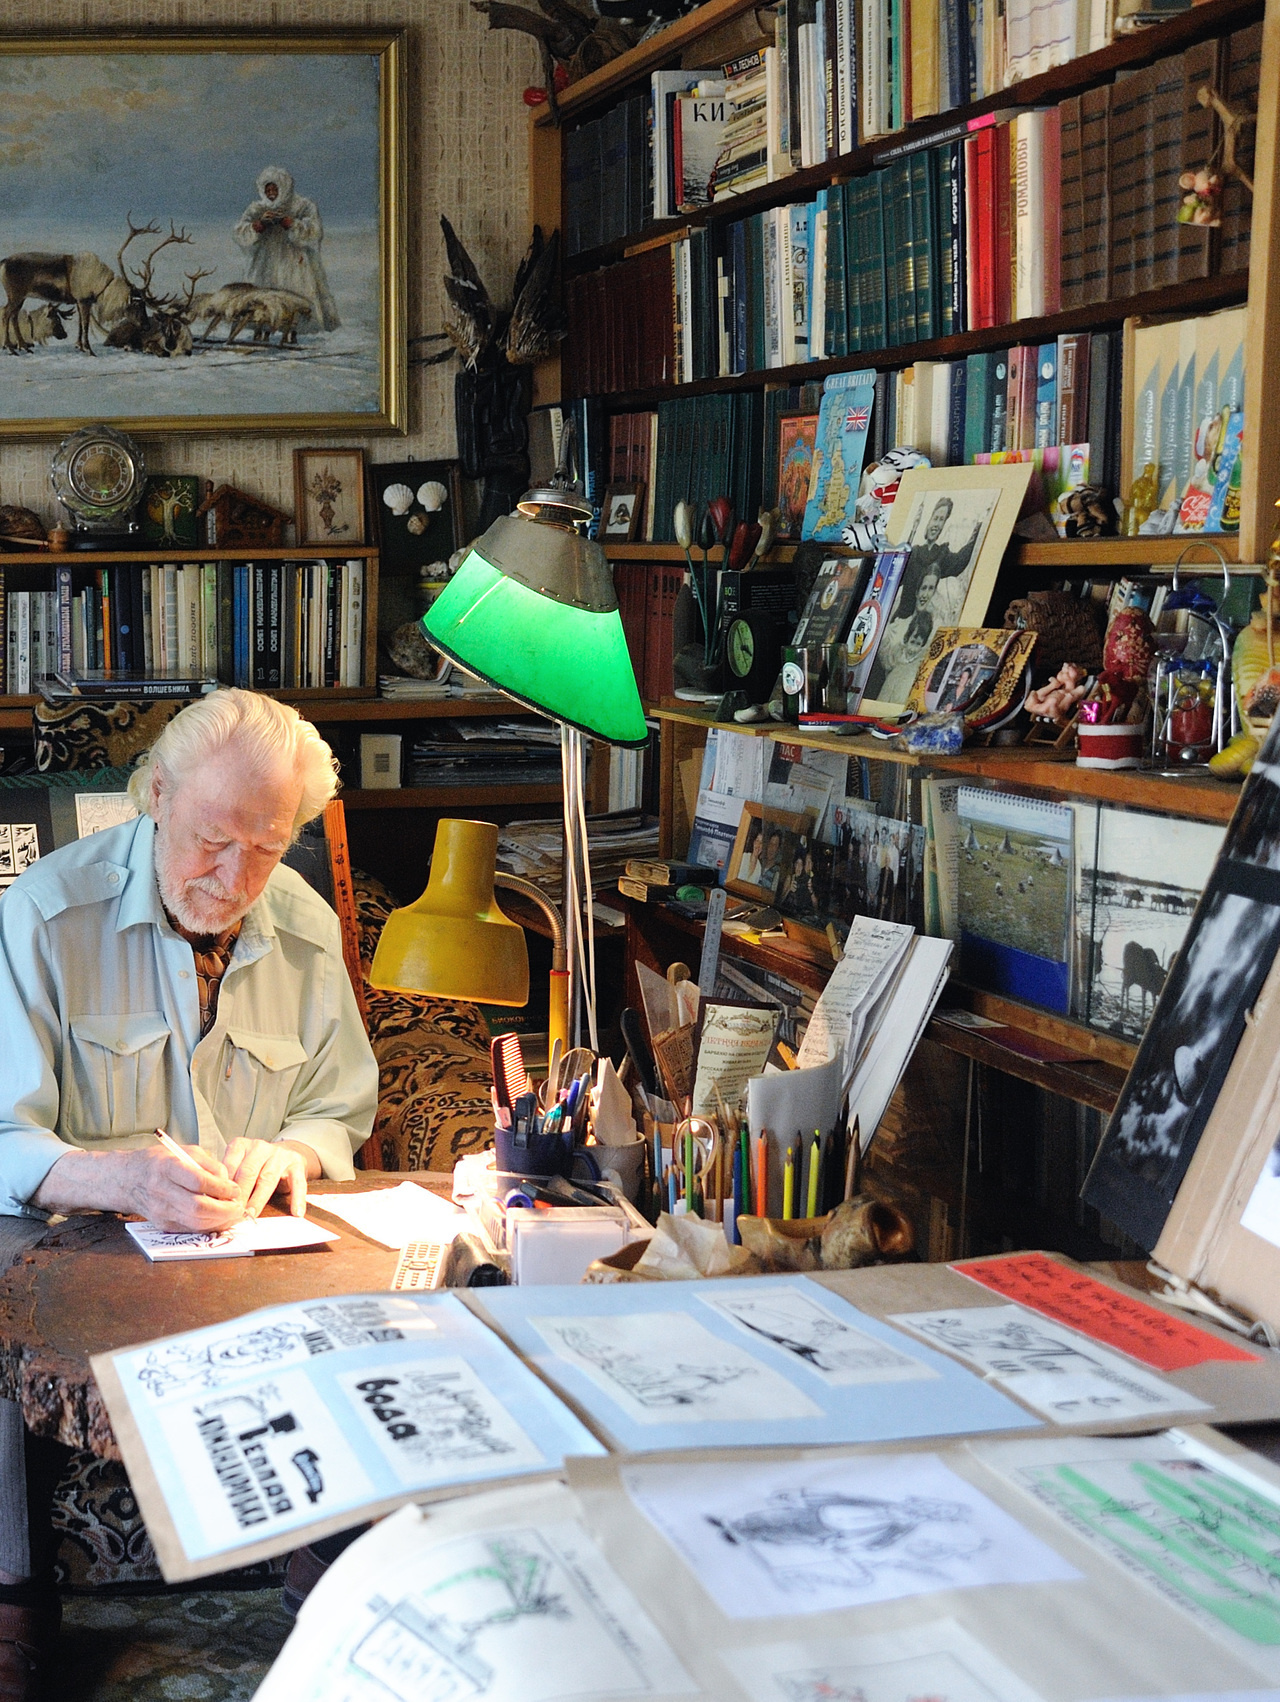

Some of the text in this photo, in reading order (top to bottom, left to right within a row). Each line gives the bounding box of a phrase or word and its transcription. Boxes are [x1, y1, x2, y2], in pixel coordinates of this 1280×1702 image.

[1017, 137, 1029, 217] РОМАНОВЫ
[826, 370, 876, 391] GREAT BRITAIN
[256, 568, 264, 626] МАНДЕЛЬШТАМ
[257, 667, 265, 679] 1
[269, 669, 279, 682] 2
[143, 685, 190, 694] ВОЛШЕБНИКА
[356, 1376, 420, 1441] вода
